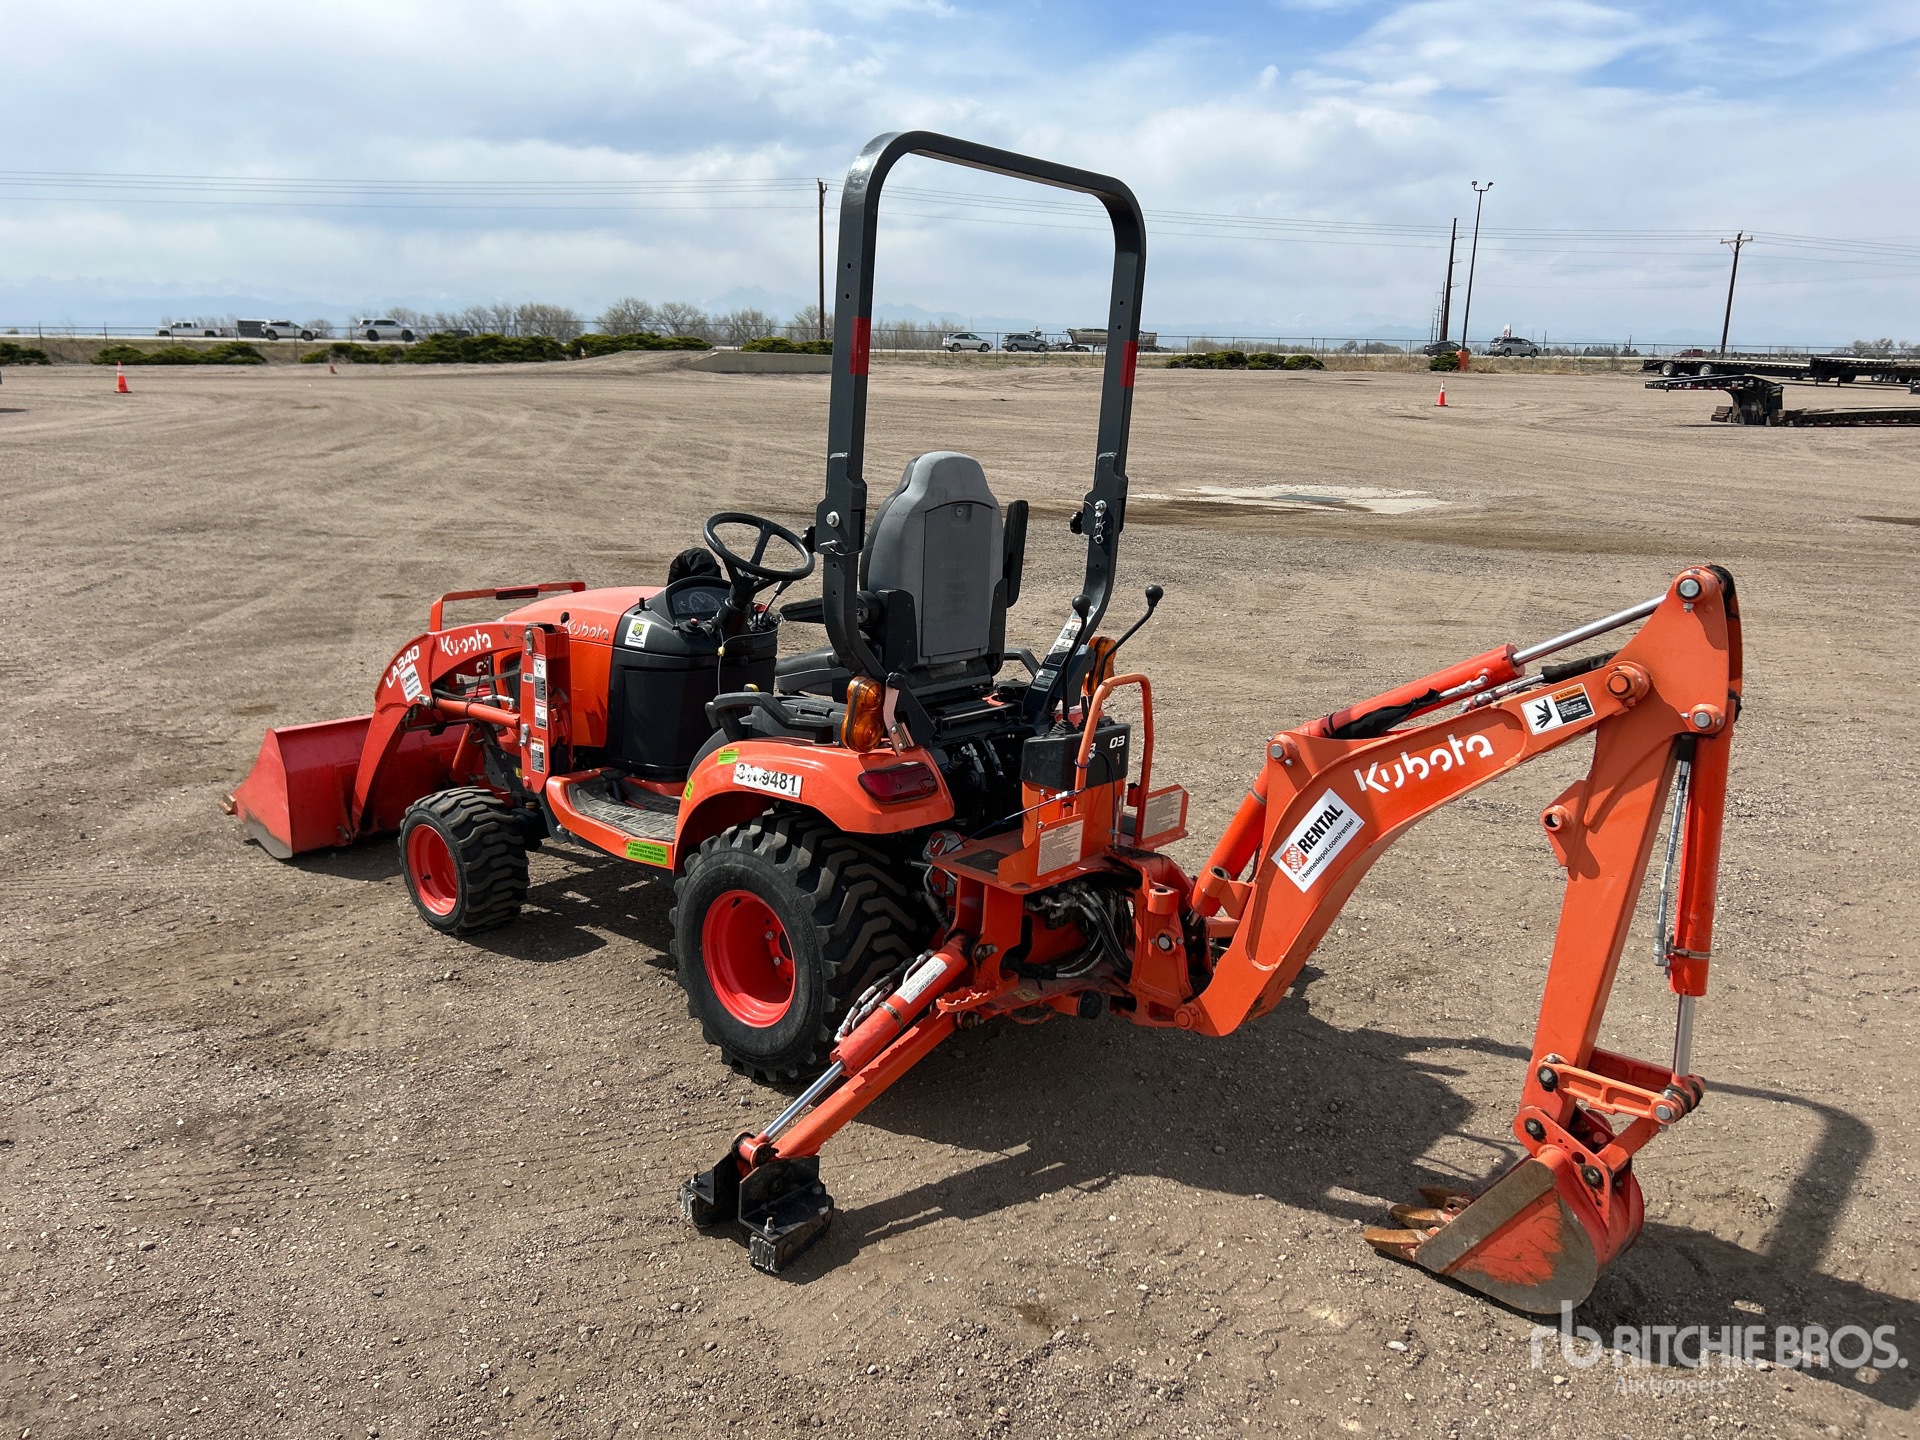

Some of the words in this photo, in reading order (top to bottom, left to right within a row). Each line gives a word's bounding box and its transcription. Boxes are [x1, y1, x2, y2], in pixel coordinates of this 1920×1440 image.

[440, 628, 492, 657] Kubota
[567, 619, 609, 641] Kubota
[386, 644, 420, 689] LA340
[1353, 733, 1495, 794] Kubota
[1297, 804, 1344, 855] RENTAL
[1302, 817, 1355, 879] homedepot.com/rental
